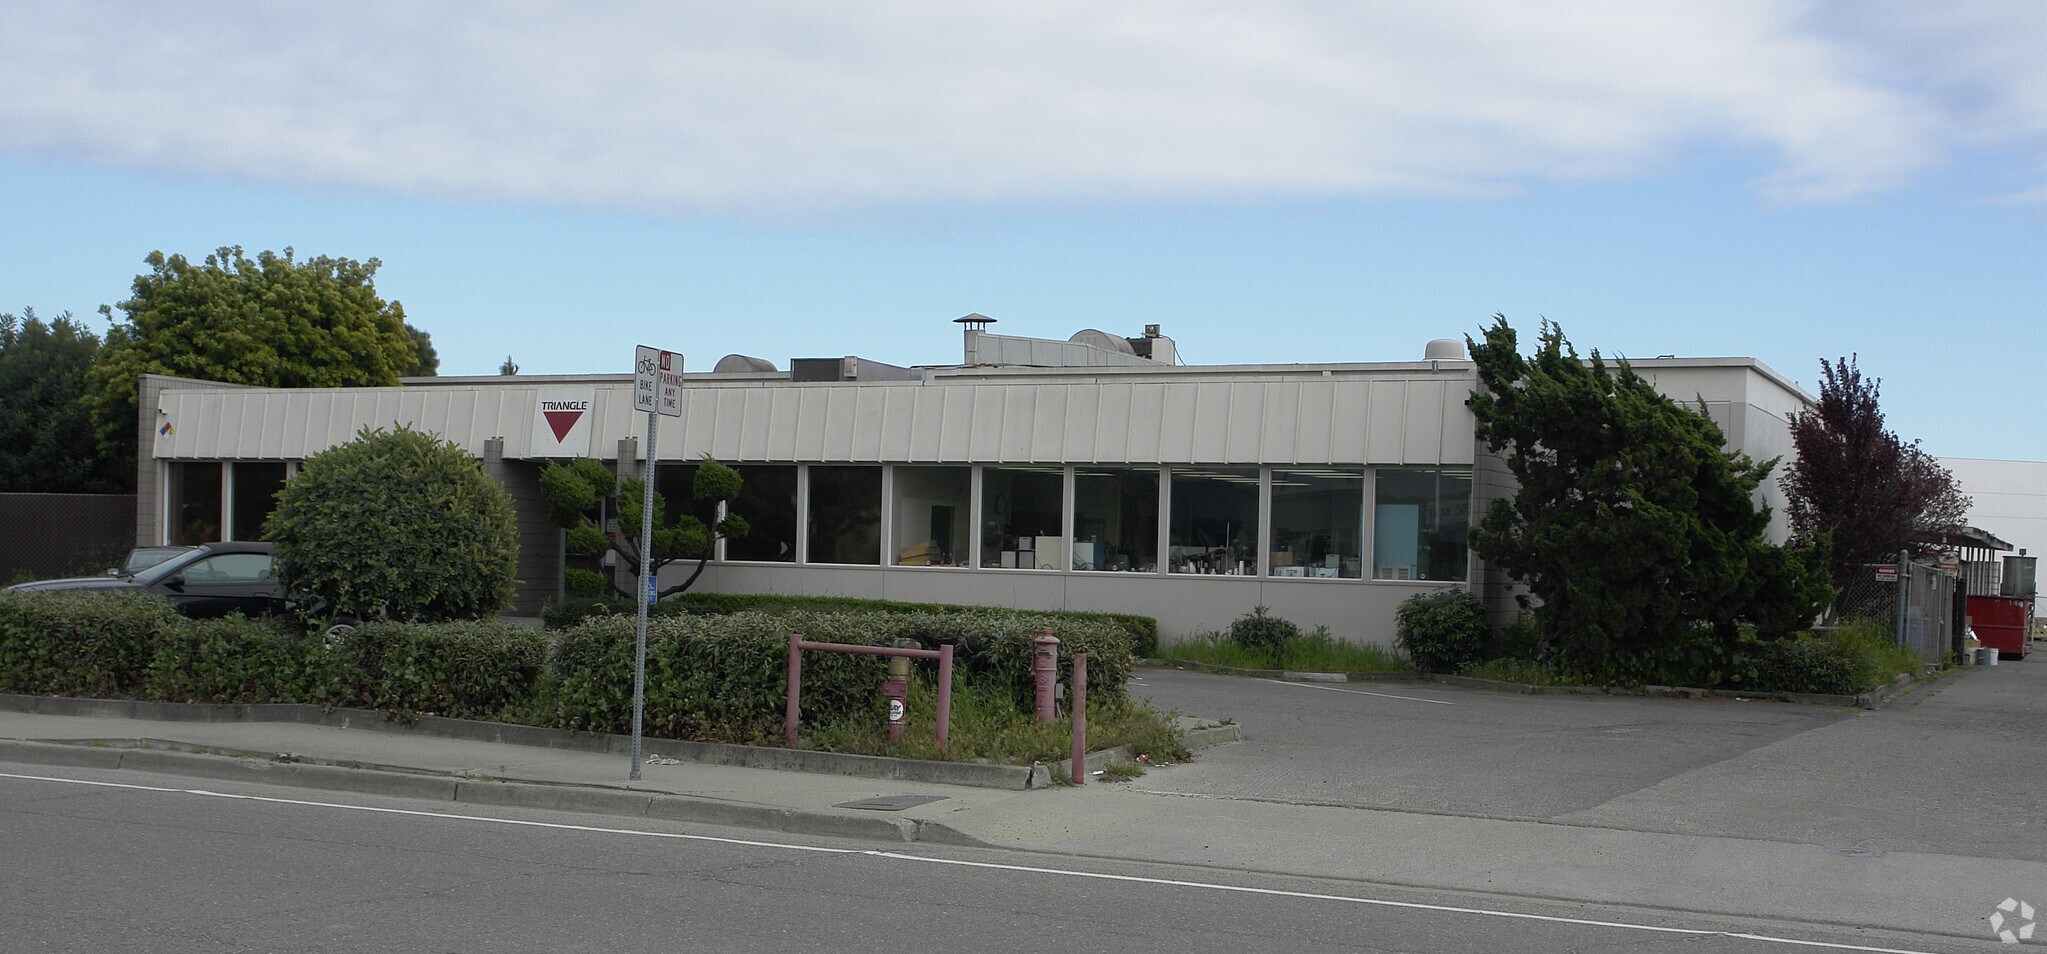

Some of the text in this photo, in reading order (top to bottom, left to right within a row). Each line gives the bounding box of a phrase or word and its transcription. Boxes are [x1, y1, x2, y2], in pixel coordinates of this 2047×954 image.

[661, 353, 670, 369] NO
[660, 372, 682, 387] PARKING
[640, 380, 652, 391] BIKE
[665, 387, 675, 397] ANY
[541, 401, 588, 410] TRIANGLE
[639, 394, 652, 406] LANE
[664, 398, 675, 408] TIME
